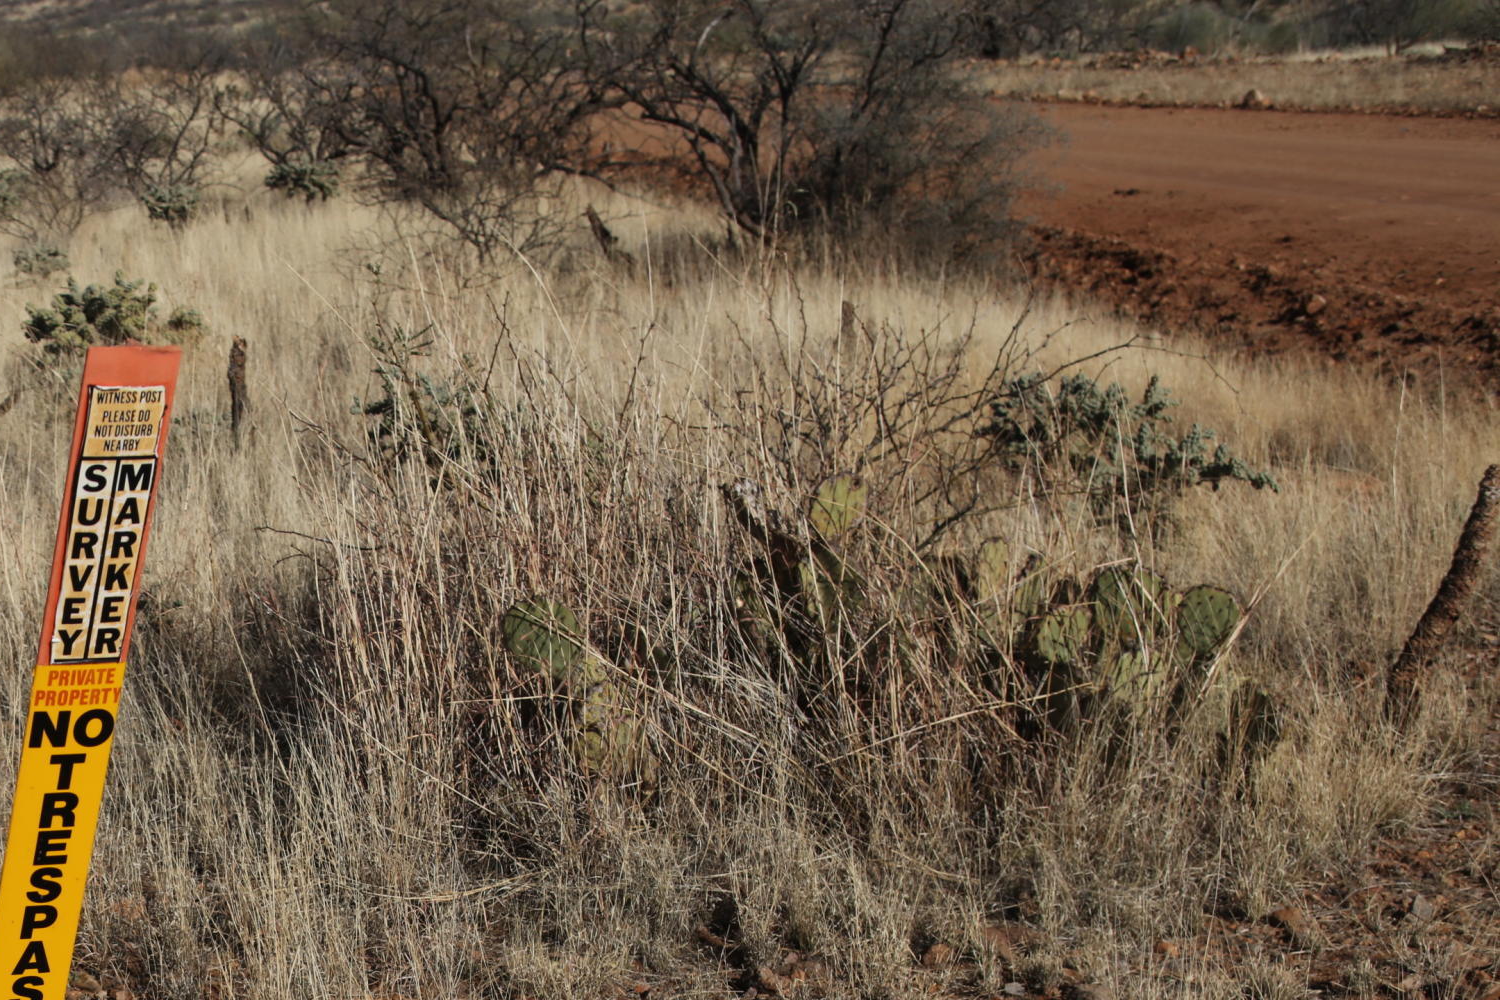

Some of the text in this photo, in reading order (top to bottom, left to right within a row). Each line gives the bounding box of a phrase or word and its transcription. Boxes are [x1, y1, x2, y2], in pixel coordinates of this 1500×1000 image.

[97, 390, 162, 404] WITNESS POST
[102, 410, 150, 423] PLEASE DO
[94, 424, 153, 437] NOT DISTURB
[103, 439, 140, 452] NEARBY
[58, 464, 108, 656] SURVEY
[94, 463, 153, 655] MARKER
[47, 668, 116, 686] PRIVATE
[34, 687, 122, 706] PROPERTY
[28, 708, 115, 748] NO
